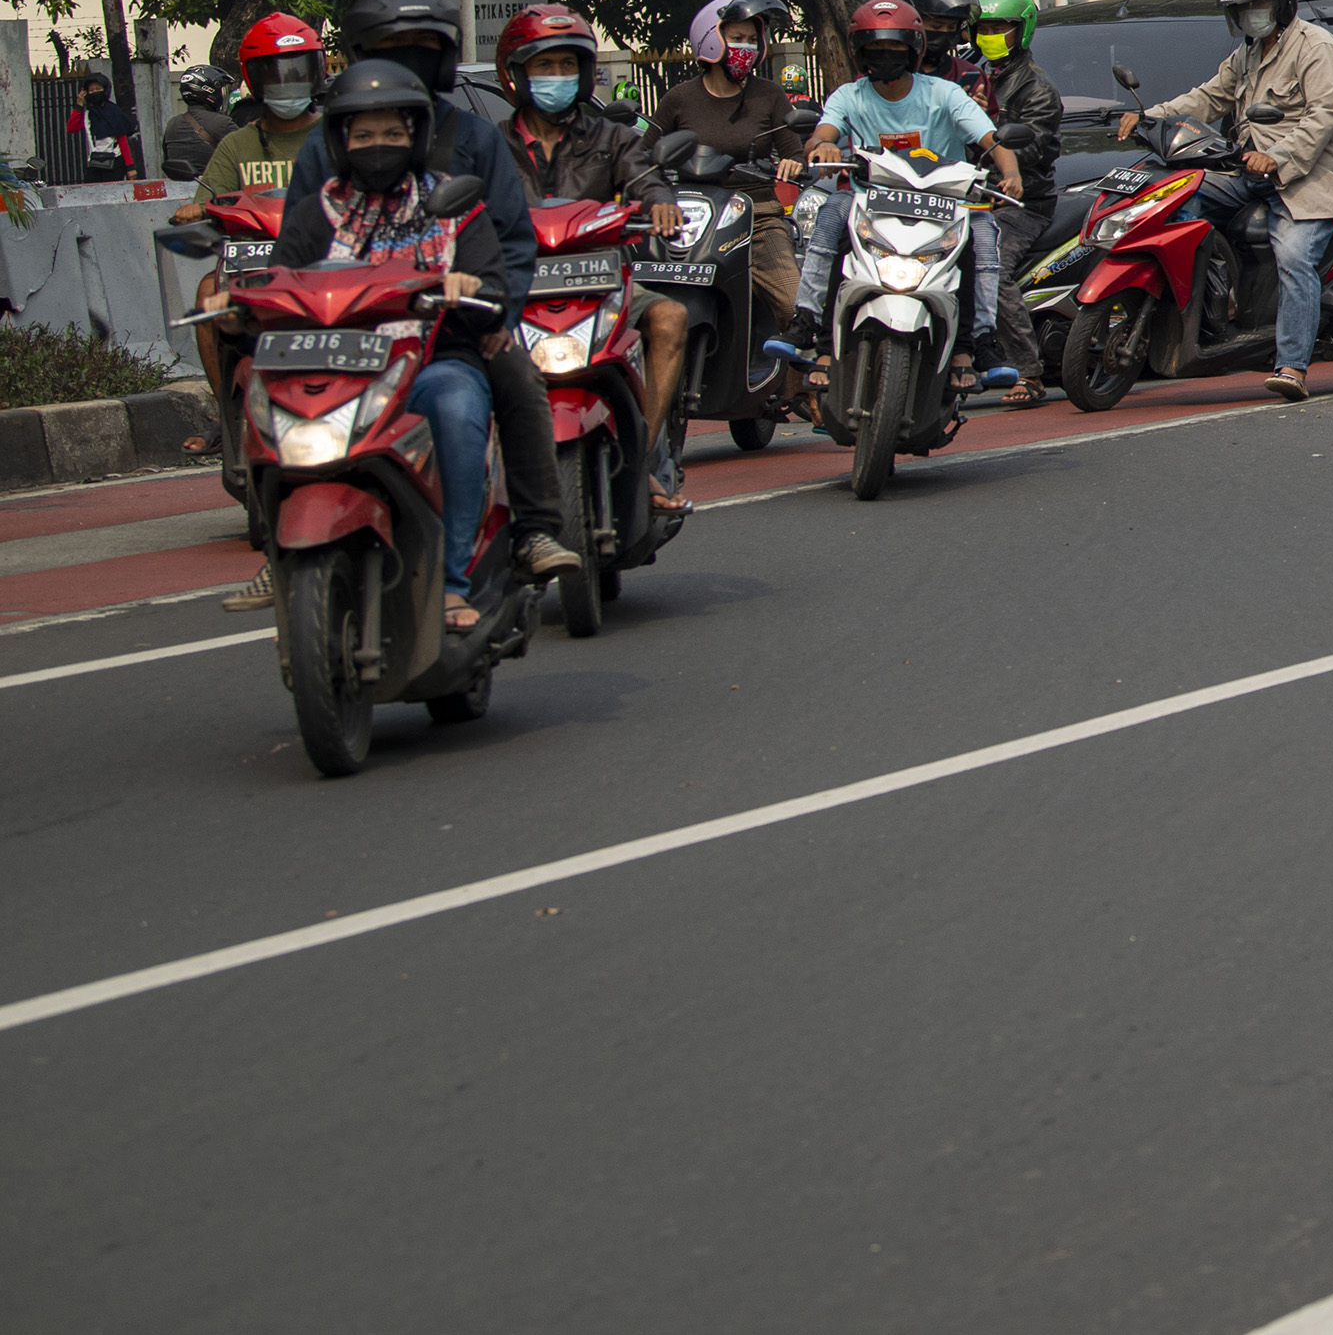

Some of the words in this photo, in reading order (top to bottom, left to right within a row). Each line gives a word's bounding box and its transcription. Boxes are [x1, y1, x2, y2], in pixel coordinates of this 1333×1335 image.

[475, 4, 503, 20] RTIKA
[868, 189, 878, 200] B
[887, 192, 923, 205] 4115
[928, 196, 955, 211] BUN
[228, 246, 238, 258] B
[533, 262, 573, 278] 643
[579, 259, 611, 274] THA
[634, 263, 642, 272] B
[651, 264, 683, 273] 3836
[263, 336, 276, 350] T
[289, 334, 342, 351] 2816
[360, 336, 386, 354] WL
